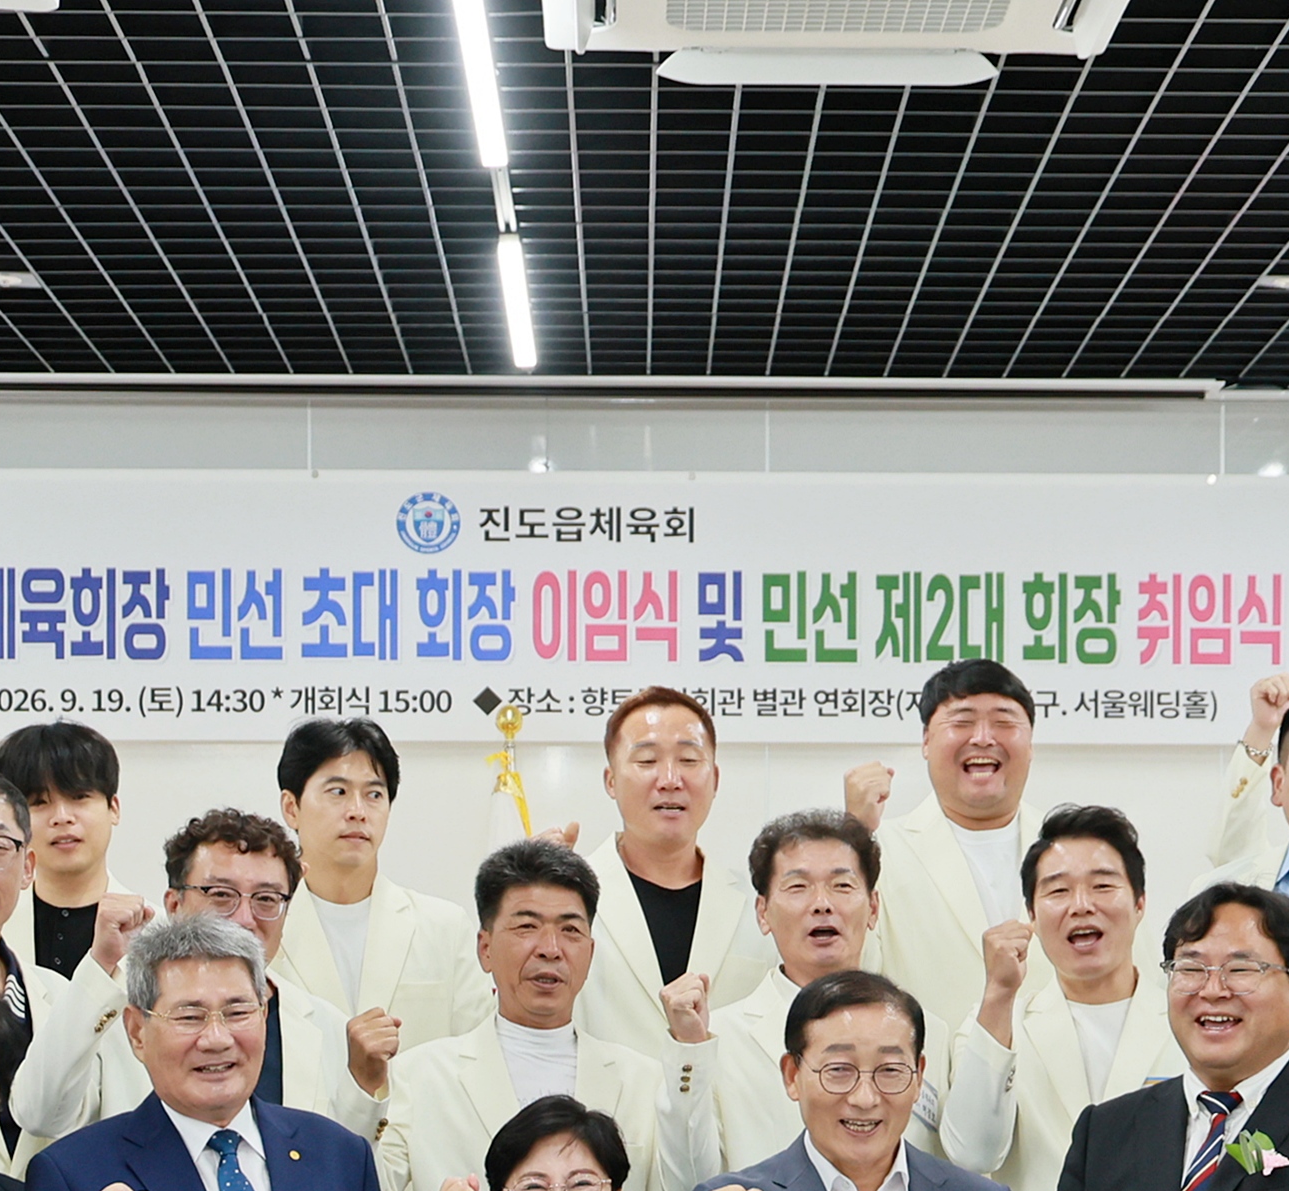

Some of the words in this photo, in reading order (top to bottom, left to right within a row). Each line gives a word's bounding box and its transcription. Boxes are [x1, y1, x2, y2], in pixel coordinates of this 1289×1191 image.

[479, 506, 695, 543] 진도읍체육회
[187, 568, 283, 661] 민선
[301, 568, 399, 661] 초대
[416, 569, 516, 662] 회장
[533, 571, 678, 662] 이임식
[698, 571, 744, 662] 및
[763, 572, 857, 663] 민선
[875, 571, 1005, 663] 제2대
[1022, 573, 1121, 664] 회장
[1137, 573, 1282, 665] 취임식
[60, 688, 84, 713] 9.
[91, 688, 131, 713] 19.
[138, 686, 184, 718] (토)
[191, 689, 266, 713] 14:30
[290, 686, 370, 716] 개회식
[378, 689, 453, 714] 15:00
[508, 686, 562, 716] 장소
[753, 688, 806, 717] 별관
[1074, 689, 1218, 722] 서울웨딩홀)
